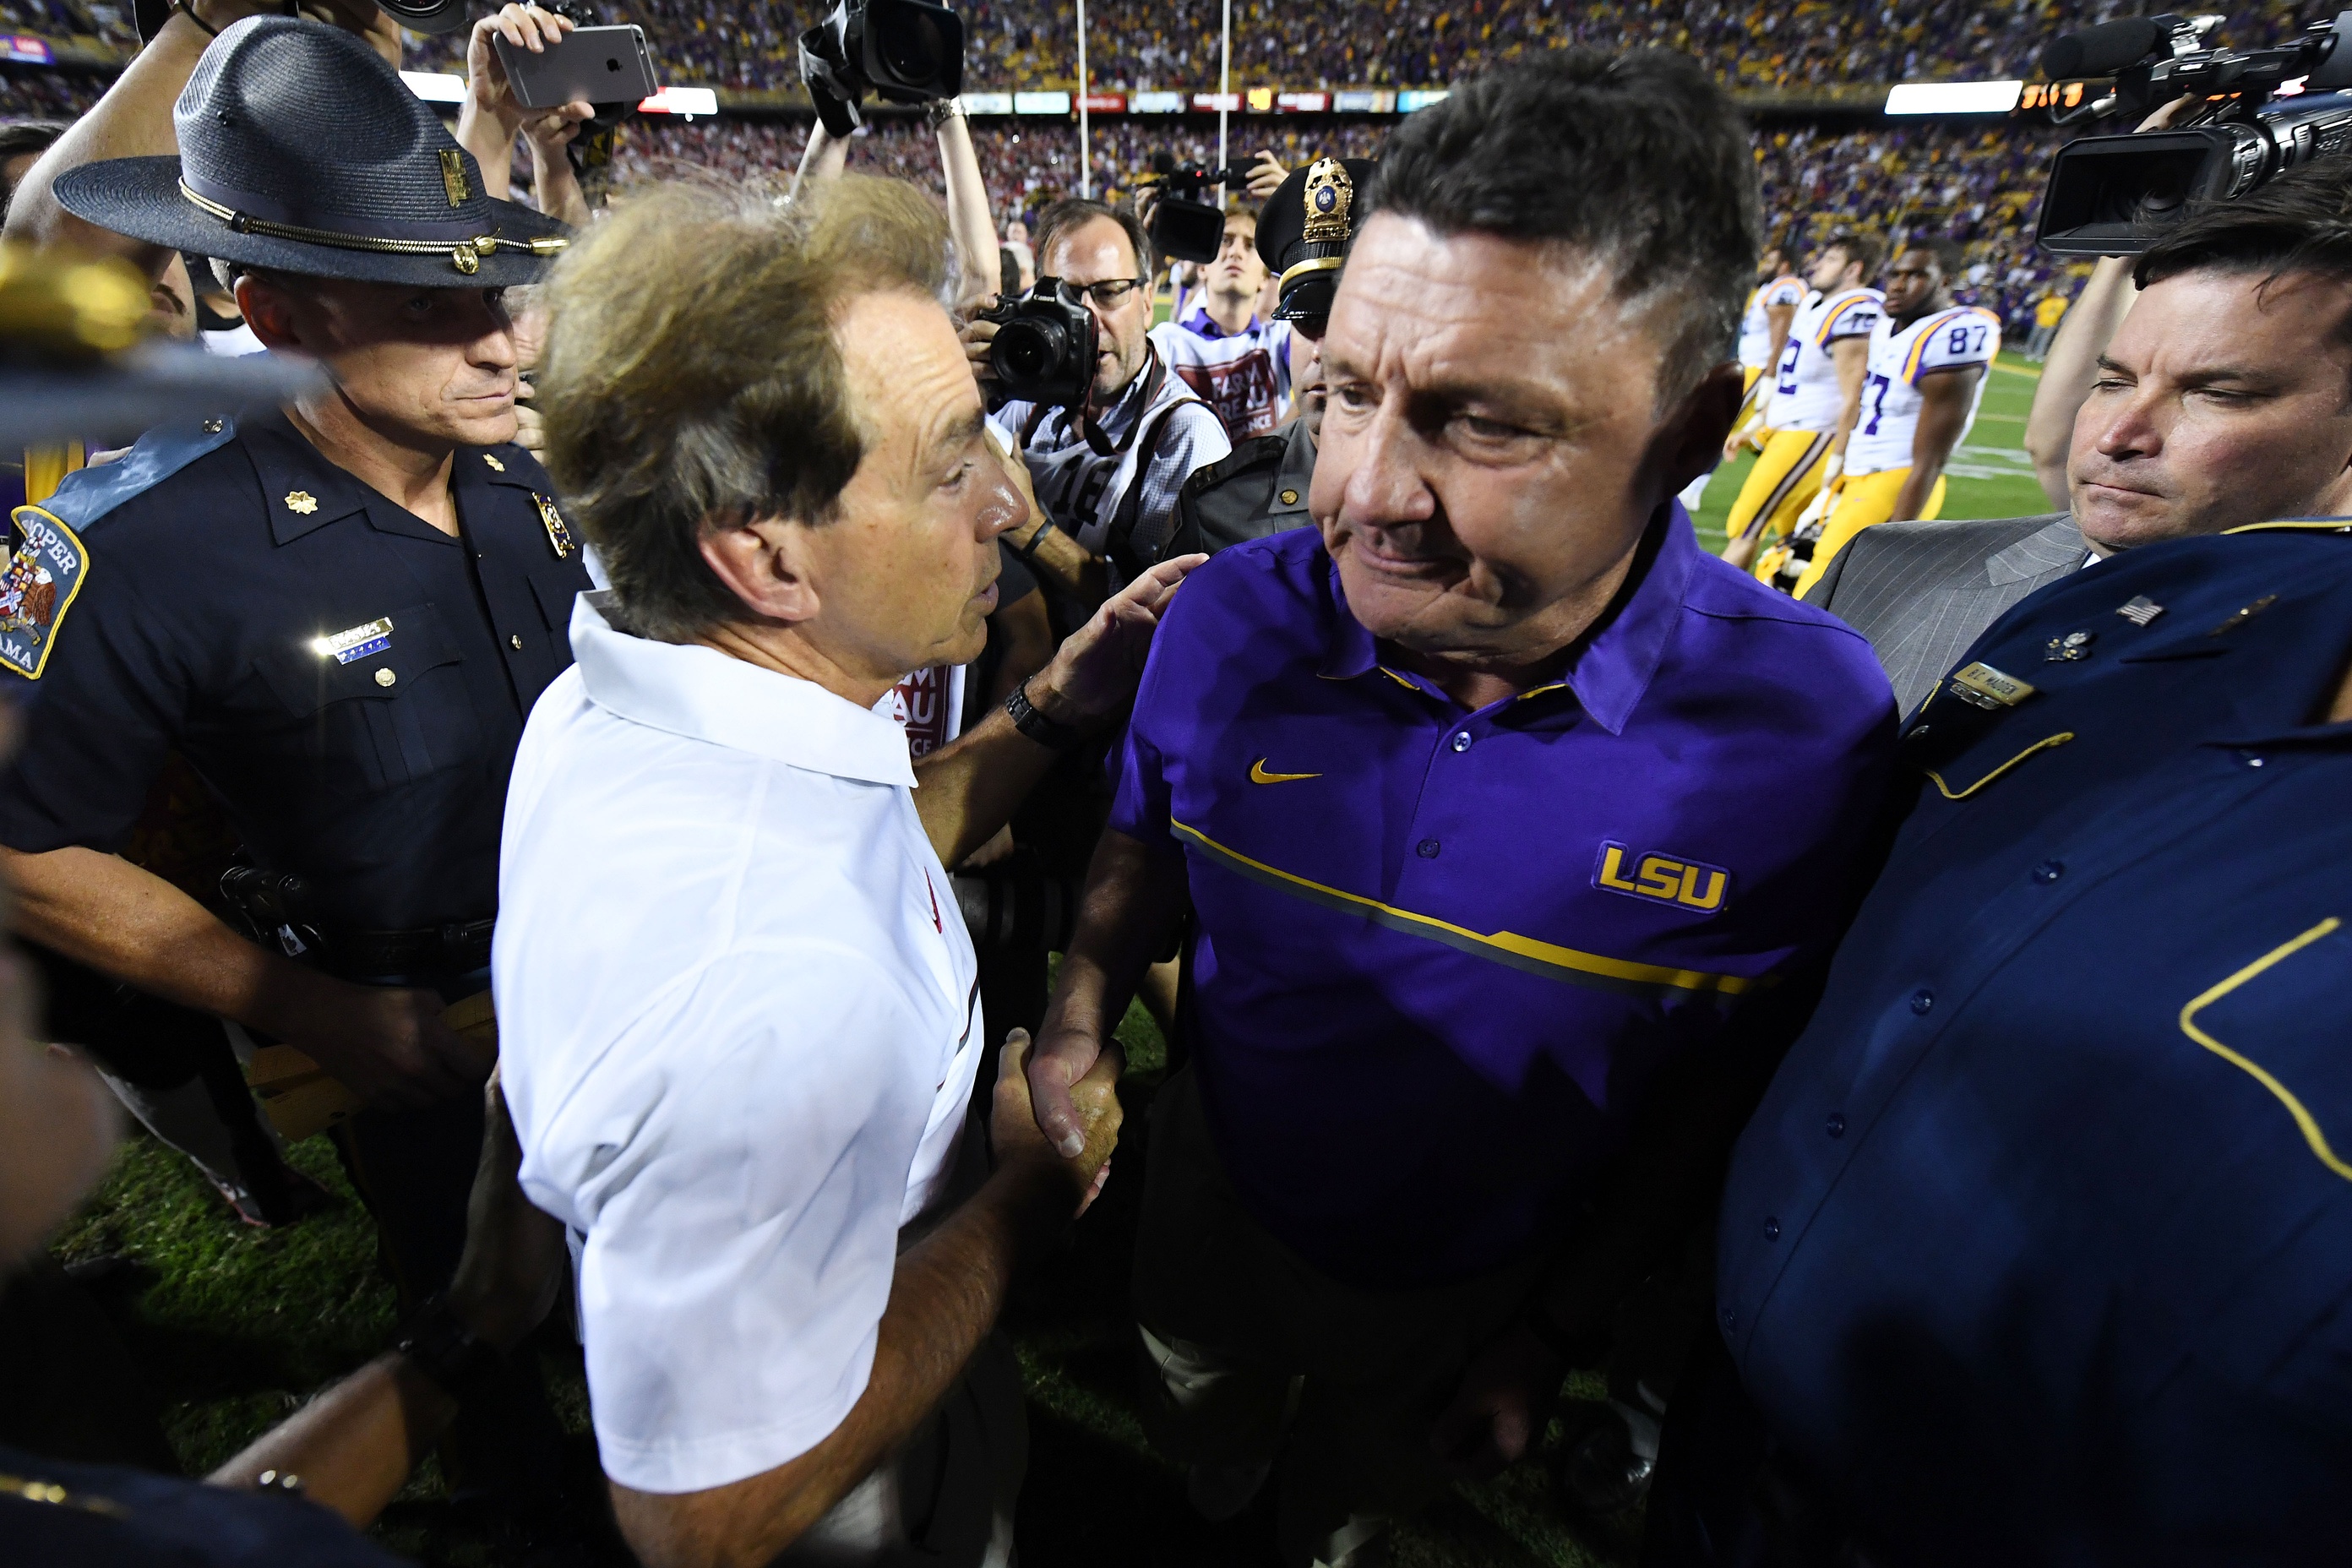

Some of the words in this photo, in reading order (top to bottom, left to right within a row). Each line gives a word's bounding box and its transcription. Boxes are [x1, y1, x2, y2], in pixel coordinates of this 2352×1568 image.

[1033, 293, 1056, 302] Canon
[1948, 324, 1987, 355] 87
[1599, 847, 1726, 909] LSU
